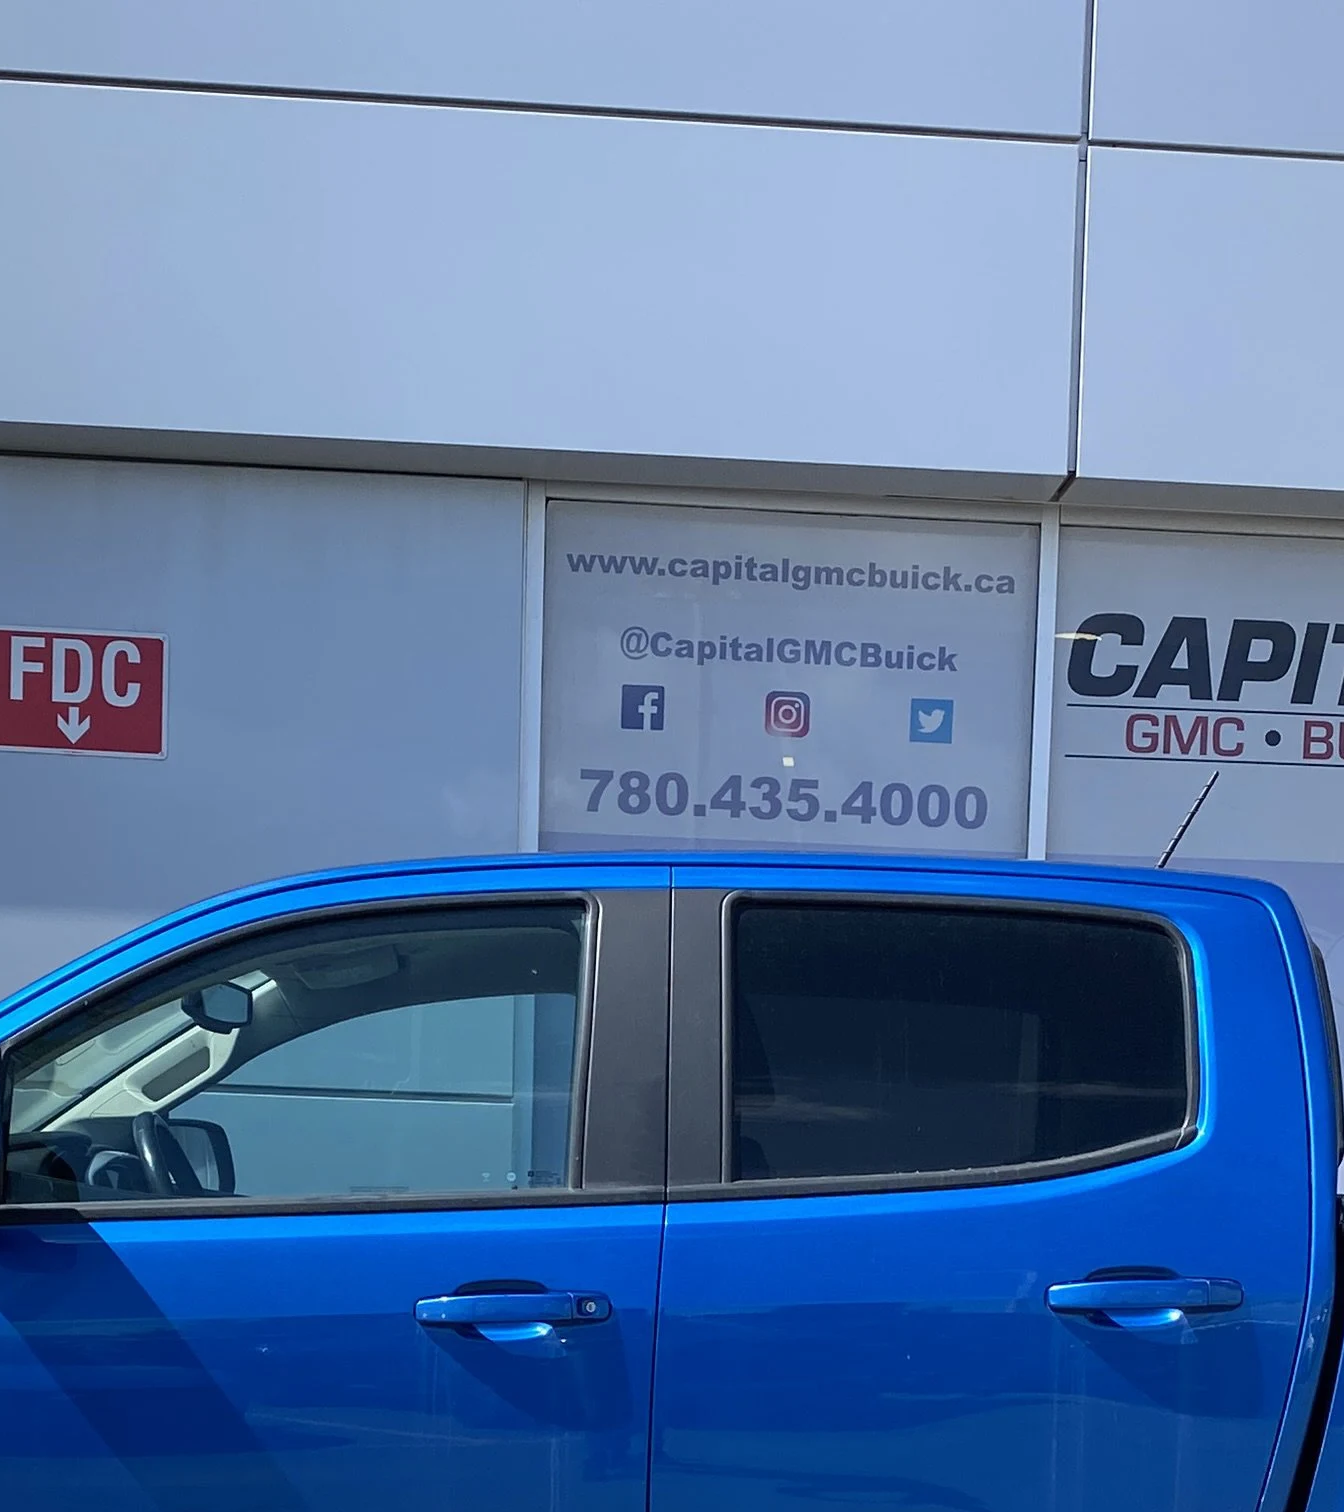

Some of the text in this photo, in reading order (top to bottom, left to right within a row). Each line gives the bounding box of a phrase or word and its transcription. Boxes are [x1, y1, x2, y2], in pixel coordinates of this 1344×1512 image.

[567, 551, 1016, 595] www.capitalgmcbuick.ca
[9, 635, 142, 708] FDC
[620, 626, 958, 672] @CapitalGMCBuick
[1125, 713, 1245, 758] GMC
[579, 768, 989, 831] 780.435.4000
